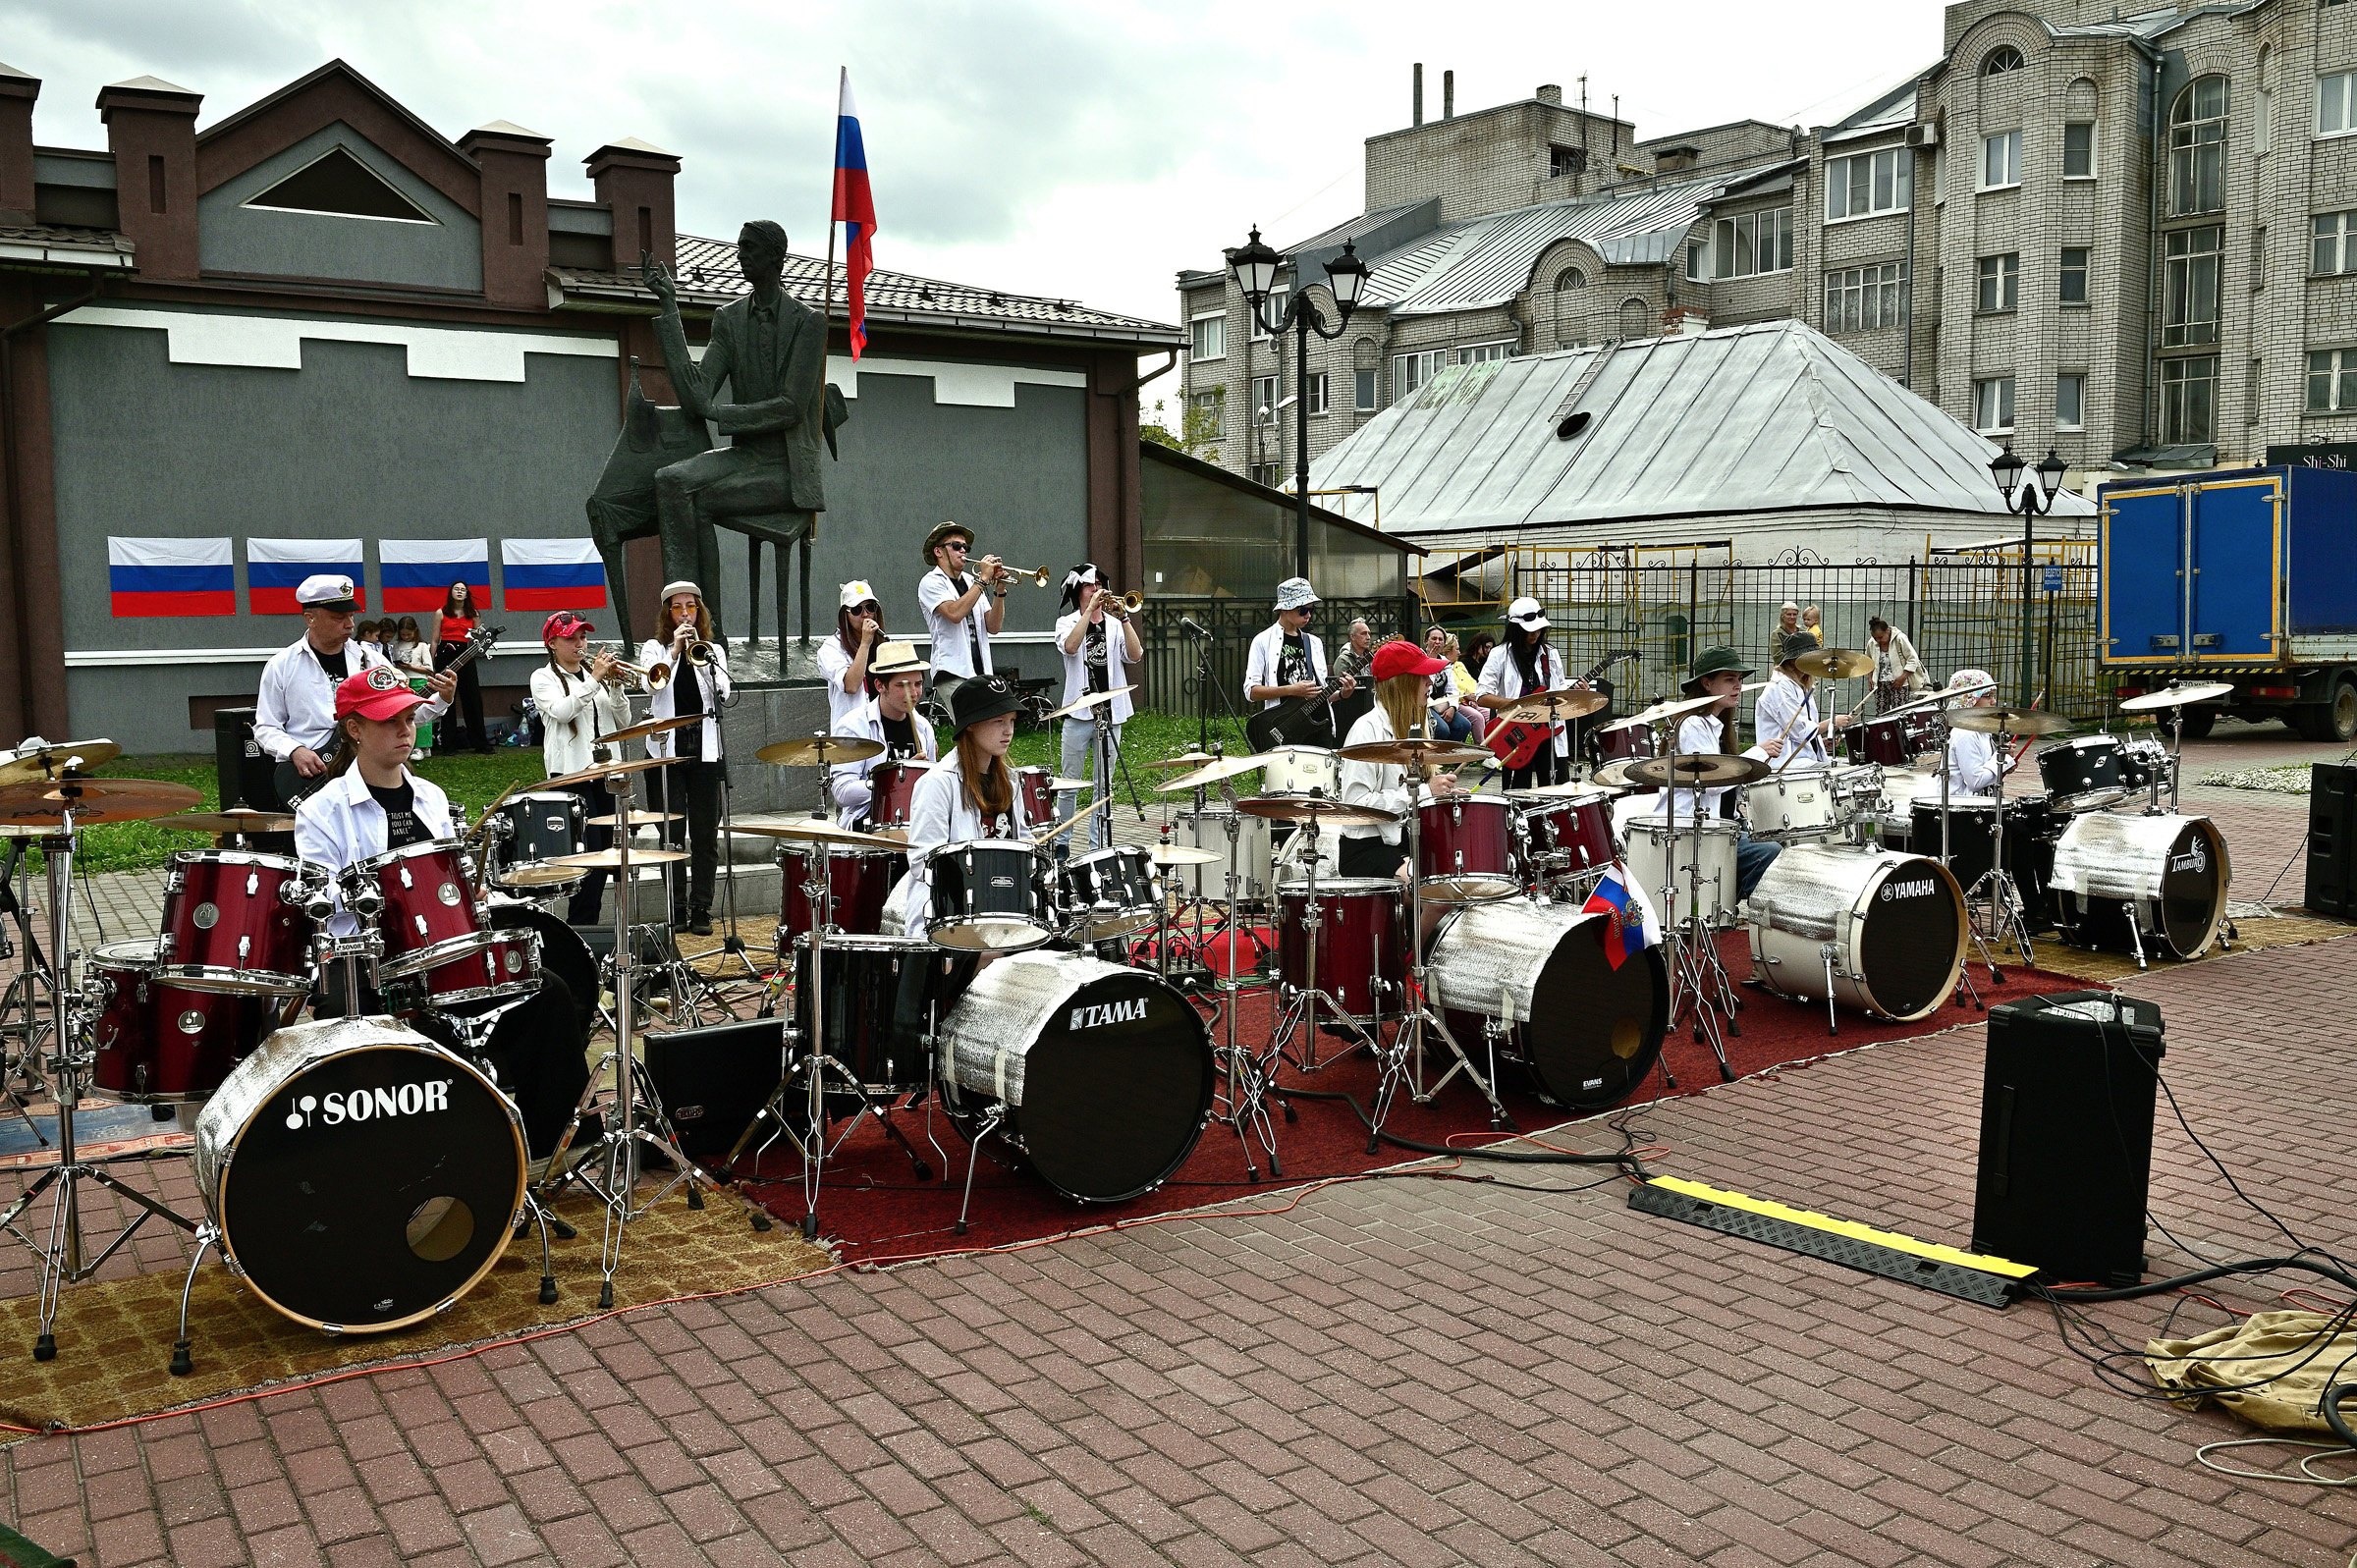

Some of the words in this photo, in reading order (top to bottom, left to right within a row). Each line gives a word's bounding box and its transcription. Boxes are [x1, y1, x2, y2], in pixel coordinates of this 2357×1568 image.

[2303, 454, 2347, 469] Shi-Shi
[1893, 879, 1935, 899] YAMAHA
[1084, 998, 1147, 1029] TAMA
[1582, 1077, 1603, 1087] EVANS
